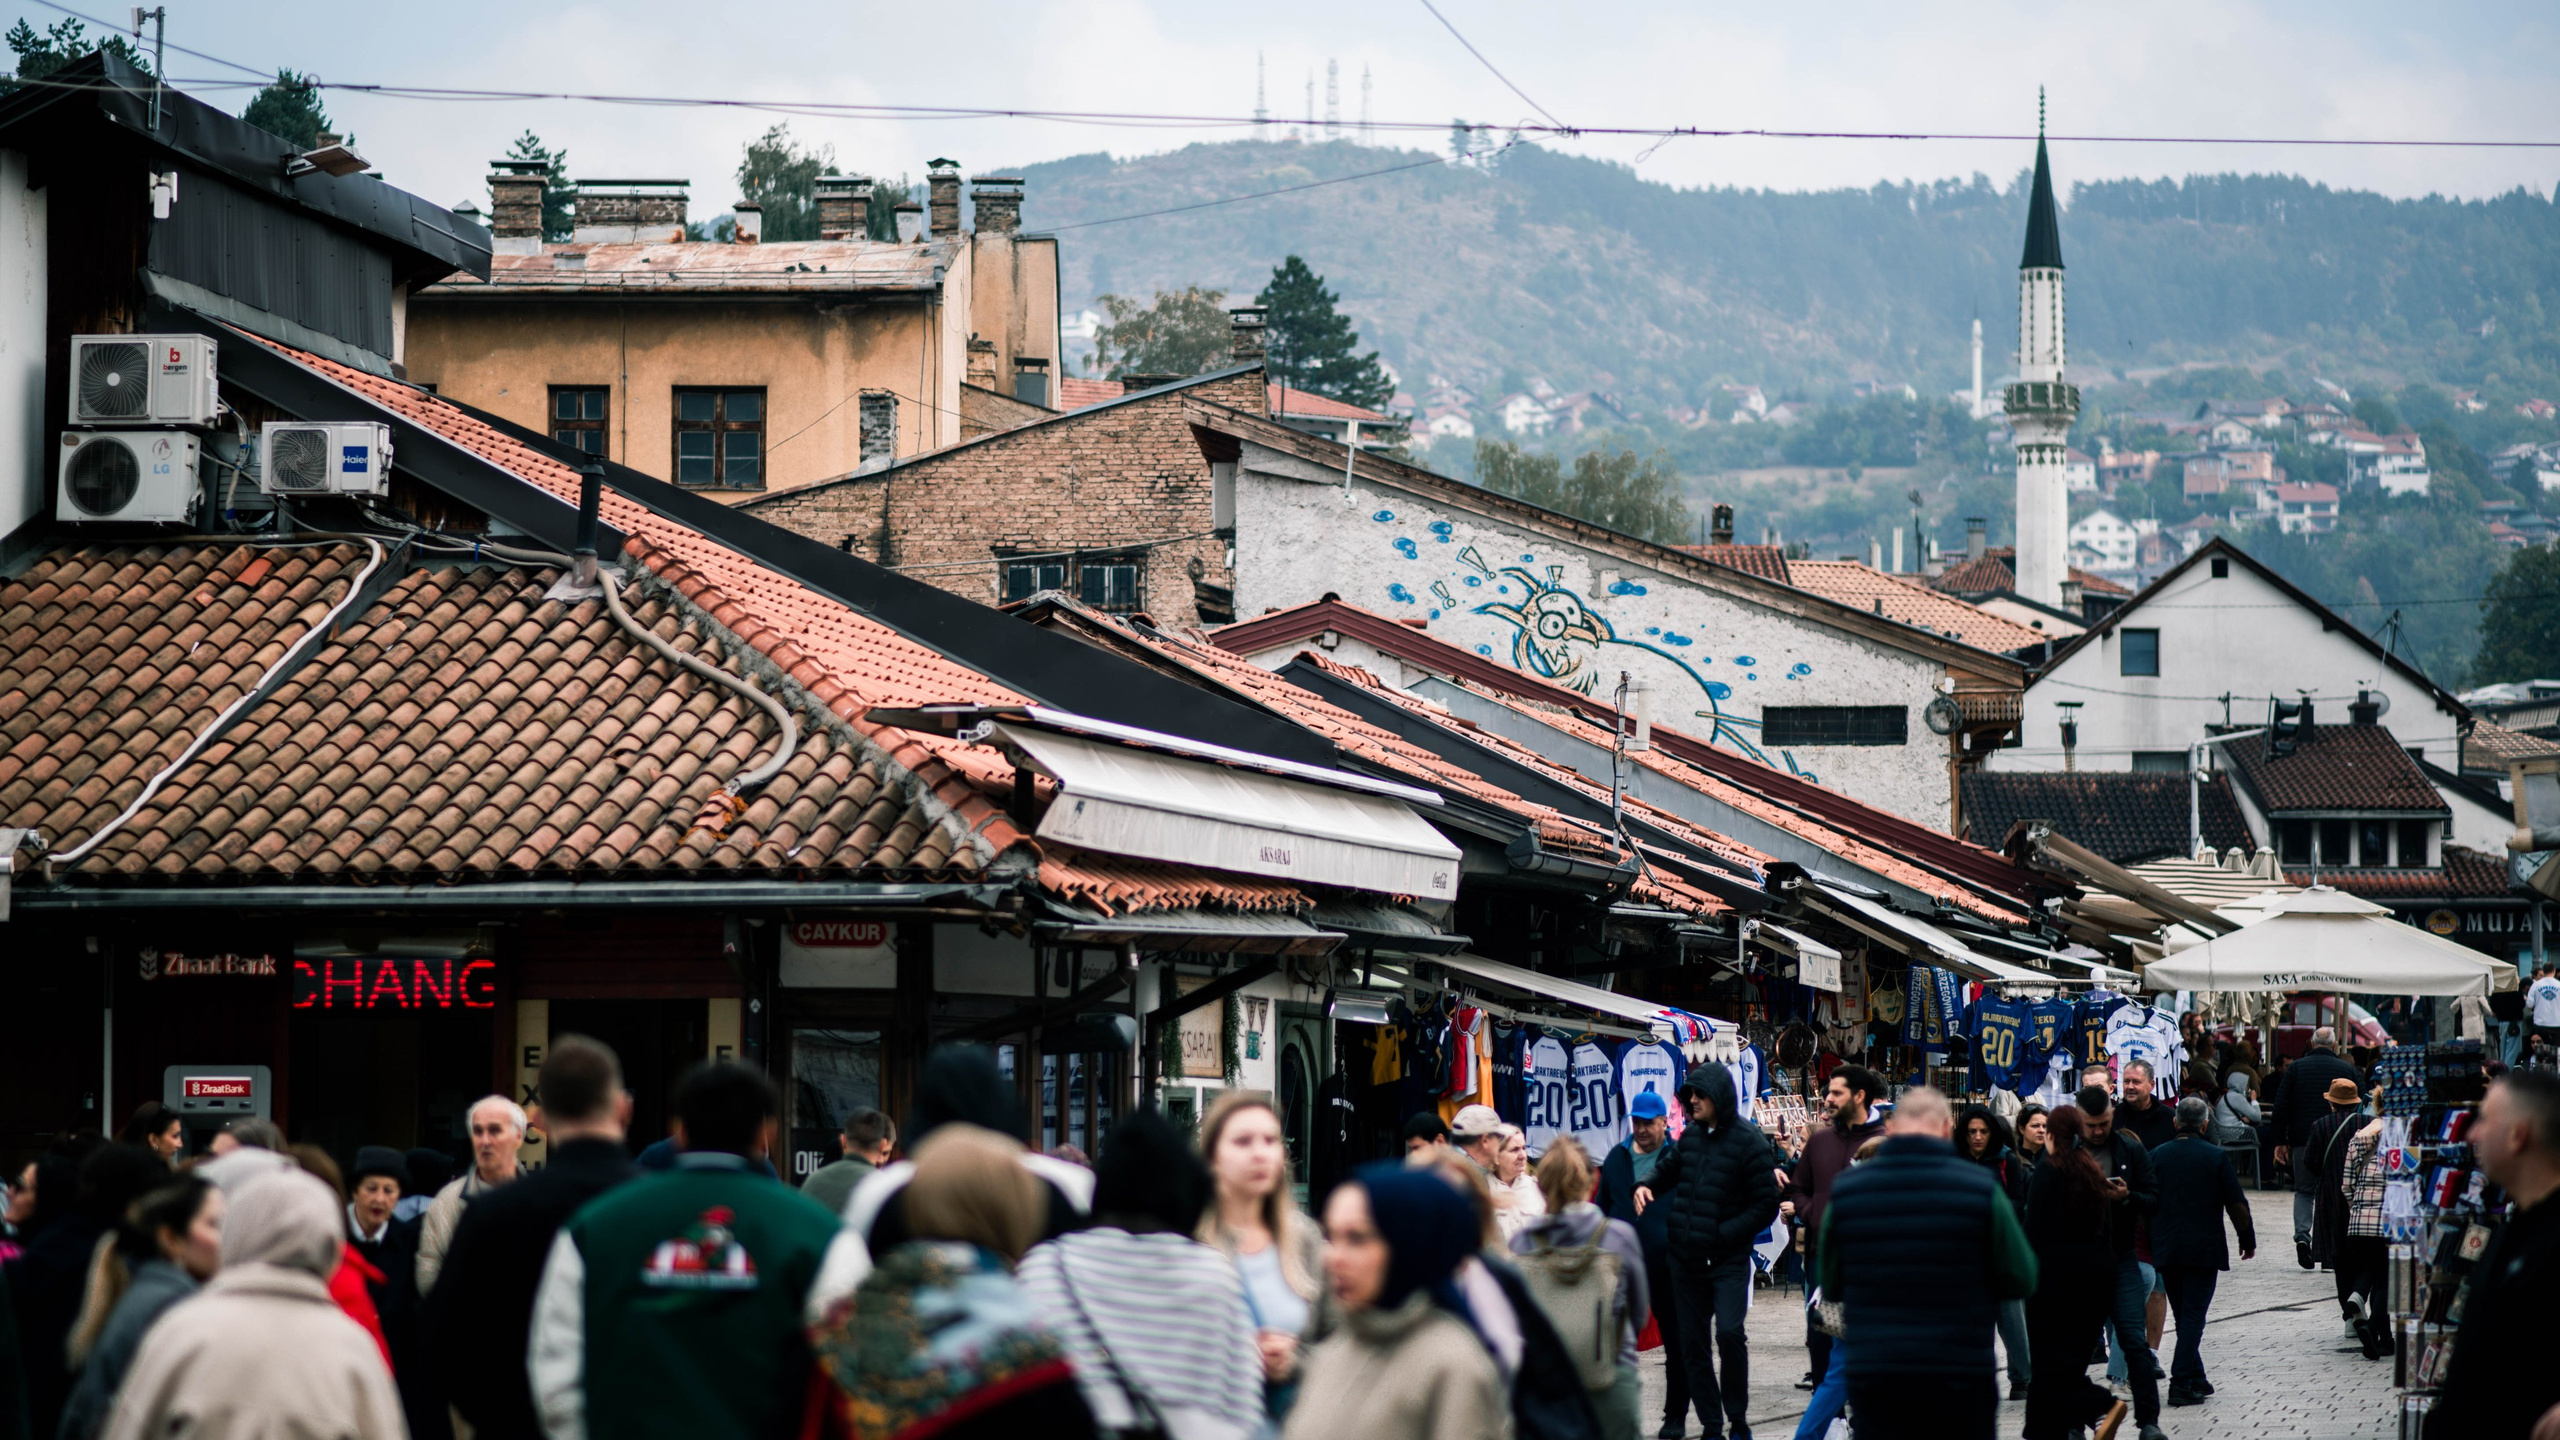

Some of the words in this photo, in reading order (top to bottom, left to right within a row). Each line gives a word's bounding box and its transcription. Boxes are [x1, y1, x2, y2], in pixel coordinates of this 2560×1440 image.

[163, 364, 187, 372] bergen
[153, 464, 170, 474] LG
[343, 455, 368, 464] Haier
[1259, 846, 1291, 866] AKSARAJ
[2466, 912, 2560, 932] MUJAN
[164, 953, 222, 975] Ziraat
[226, 953, 277, 975] Bank
[2263, 974, 2299, 985] SASA
[2301, 975, 2334, 983] BOSNIAN
[2335, 976, 2363, 985] COFFEE
[1909, 966, 1922, 1019] HERZEGOVINA
[1982, 1026, 2015, 1069] 20
[1527, 1079, 1564, 1128] 20
[1570, 1079, 1612, 1132] 20
[795, 1150, 826, 1175] Oli
